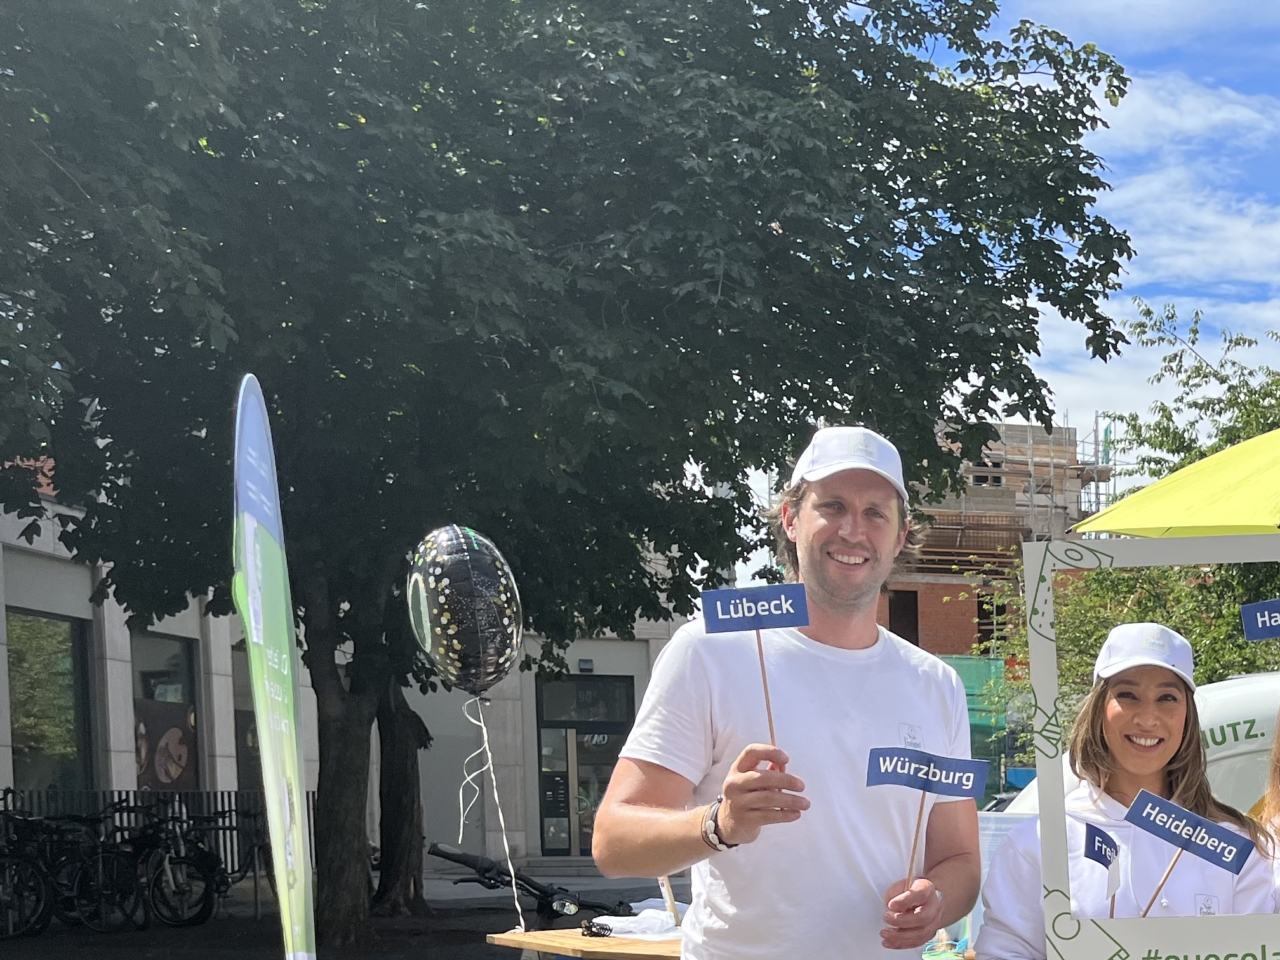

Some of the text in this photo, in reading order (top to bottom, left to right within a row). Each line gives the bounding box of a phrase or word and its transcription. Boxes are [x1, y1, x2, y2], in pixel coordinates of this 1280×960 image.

[716, 594, 795, 620] Lübeck
[878, 756, 974, 790] Würzburg
[1141, 802, 1238, 863] Heidelberg
